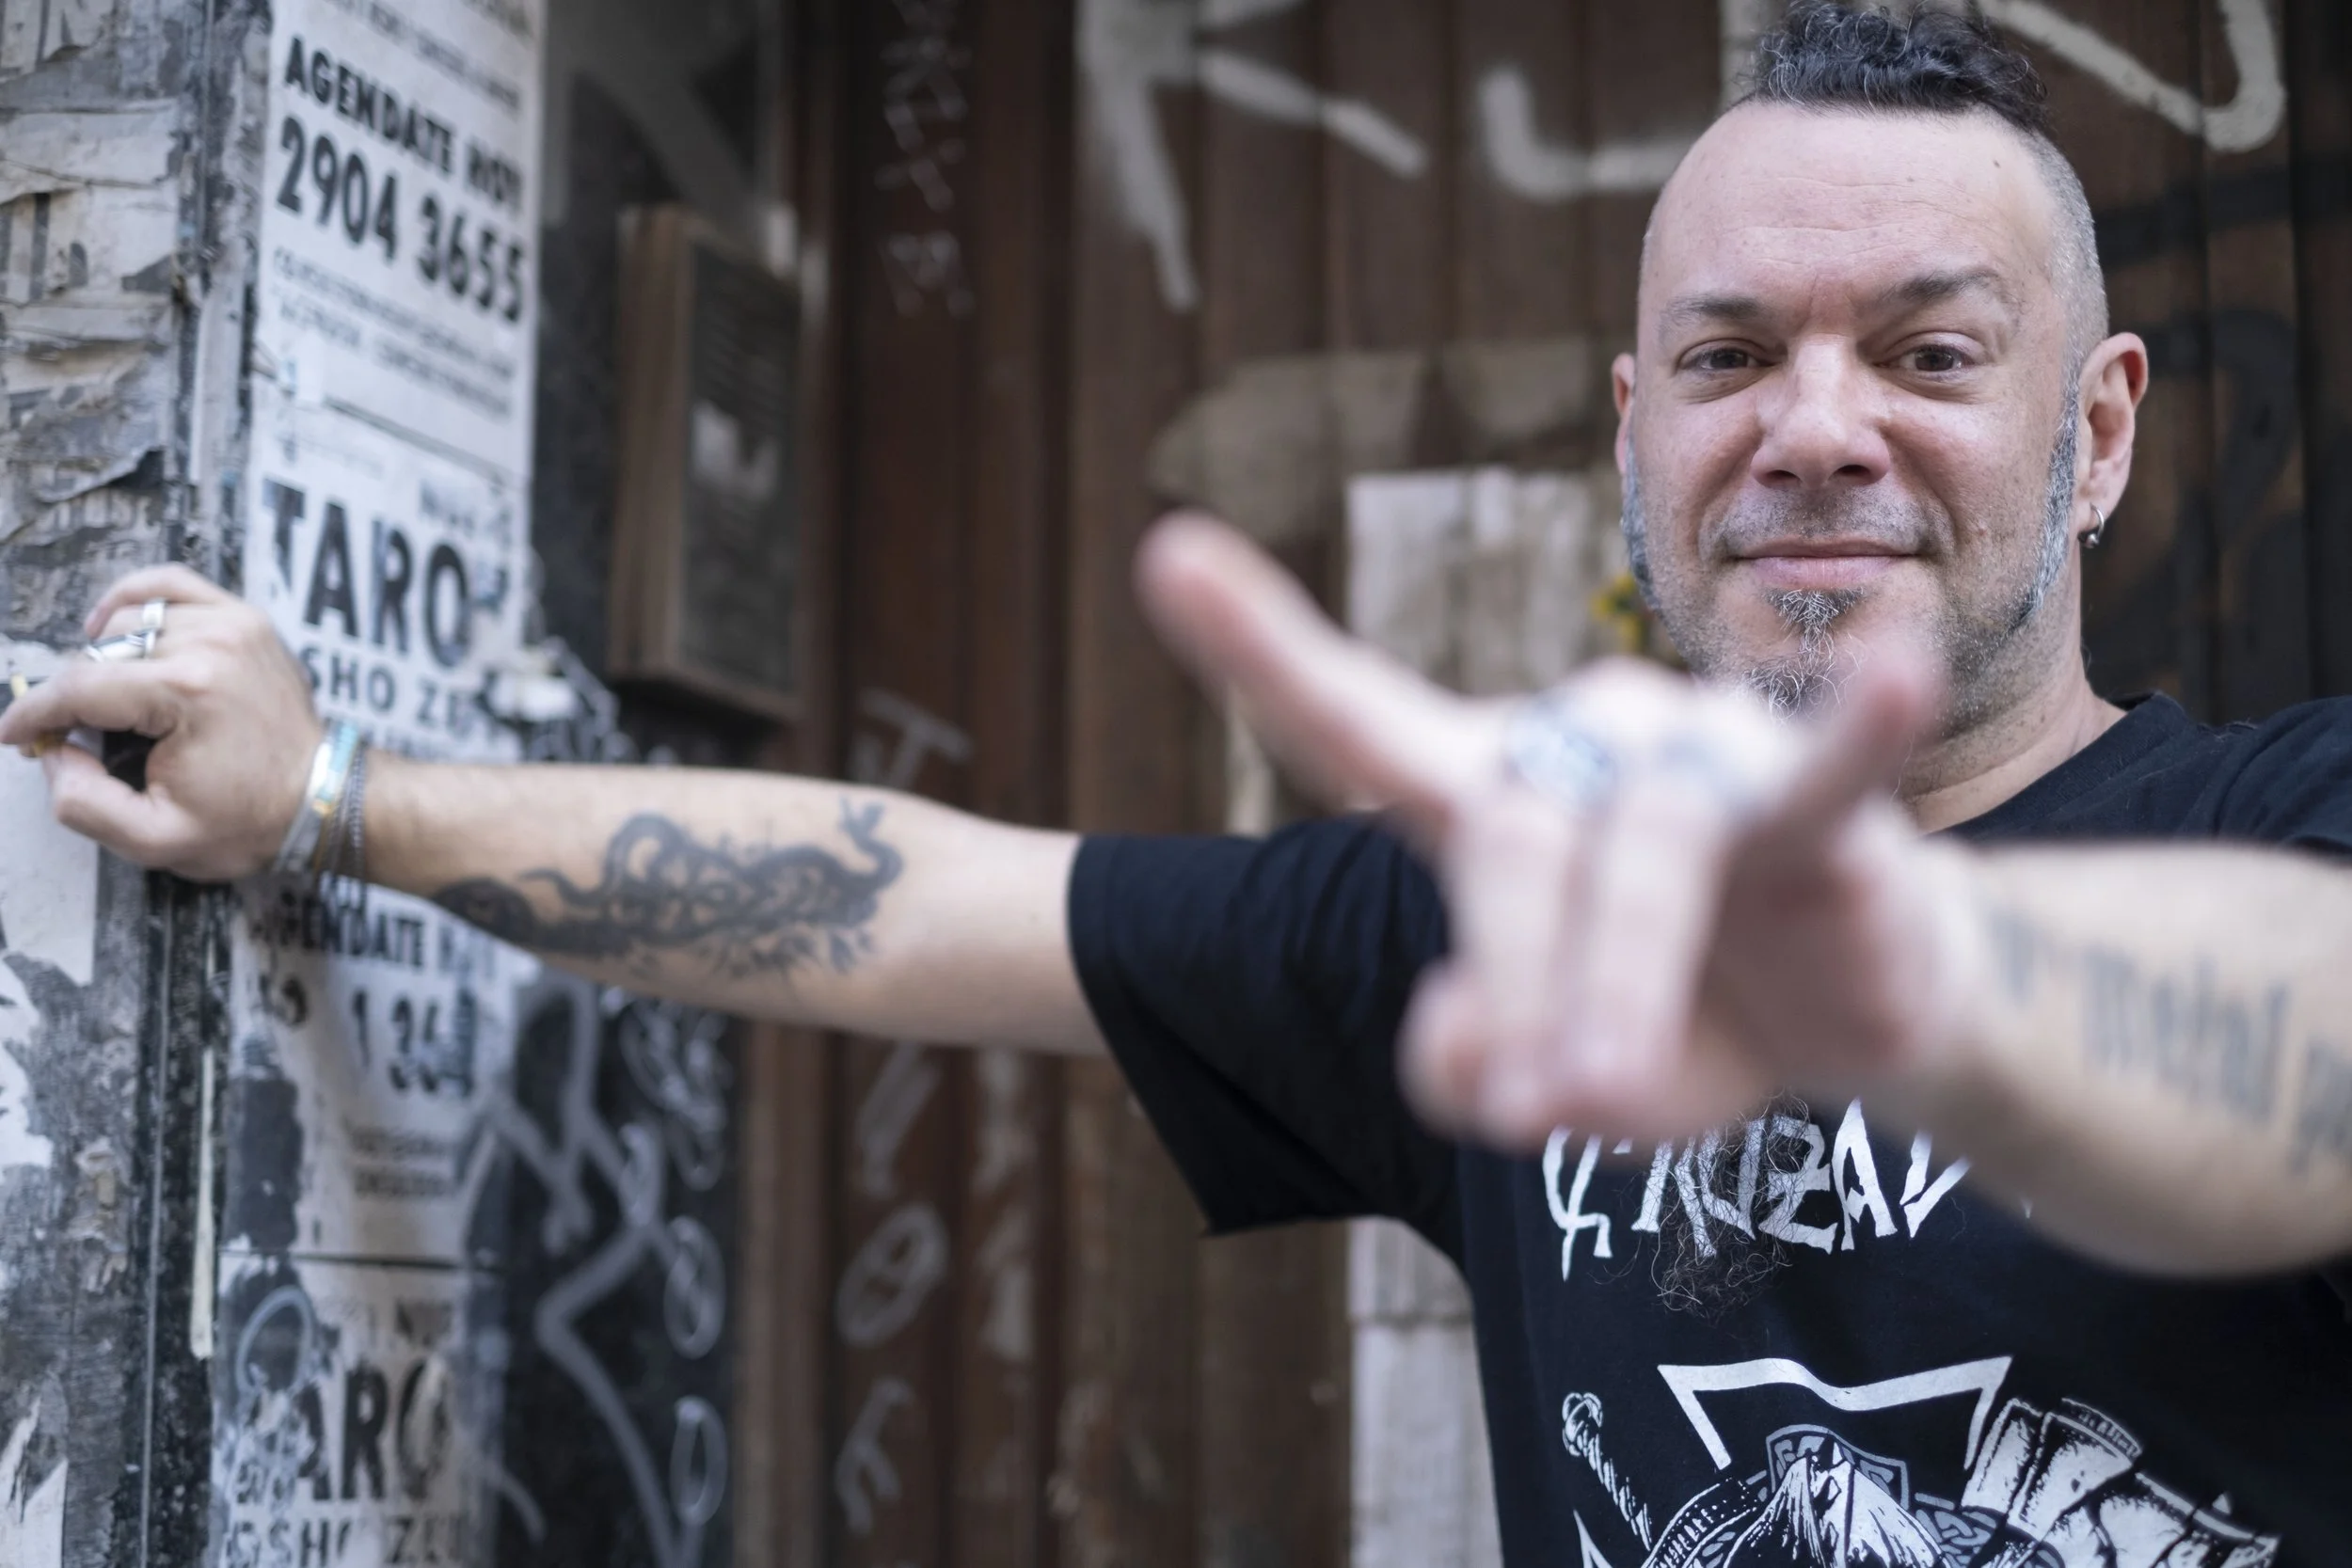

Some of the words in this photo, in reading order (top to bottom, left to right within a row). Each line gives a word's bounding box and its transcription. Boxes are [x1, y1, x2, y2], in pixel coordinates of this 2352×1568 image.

[283, 36, 455, 175] AGENDATE
[278, 117, 398, 262] 2904
[417, 193, 524, 324] 3655
[262, 476, 508, 667] TARO
[297, 645, 396, 711] SHO
